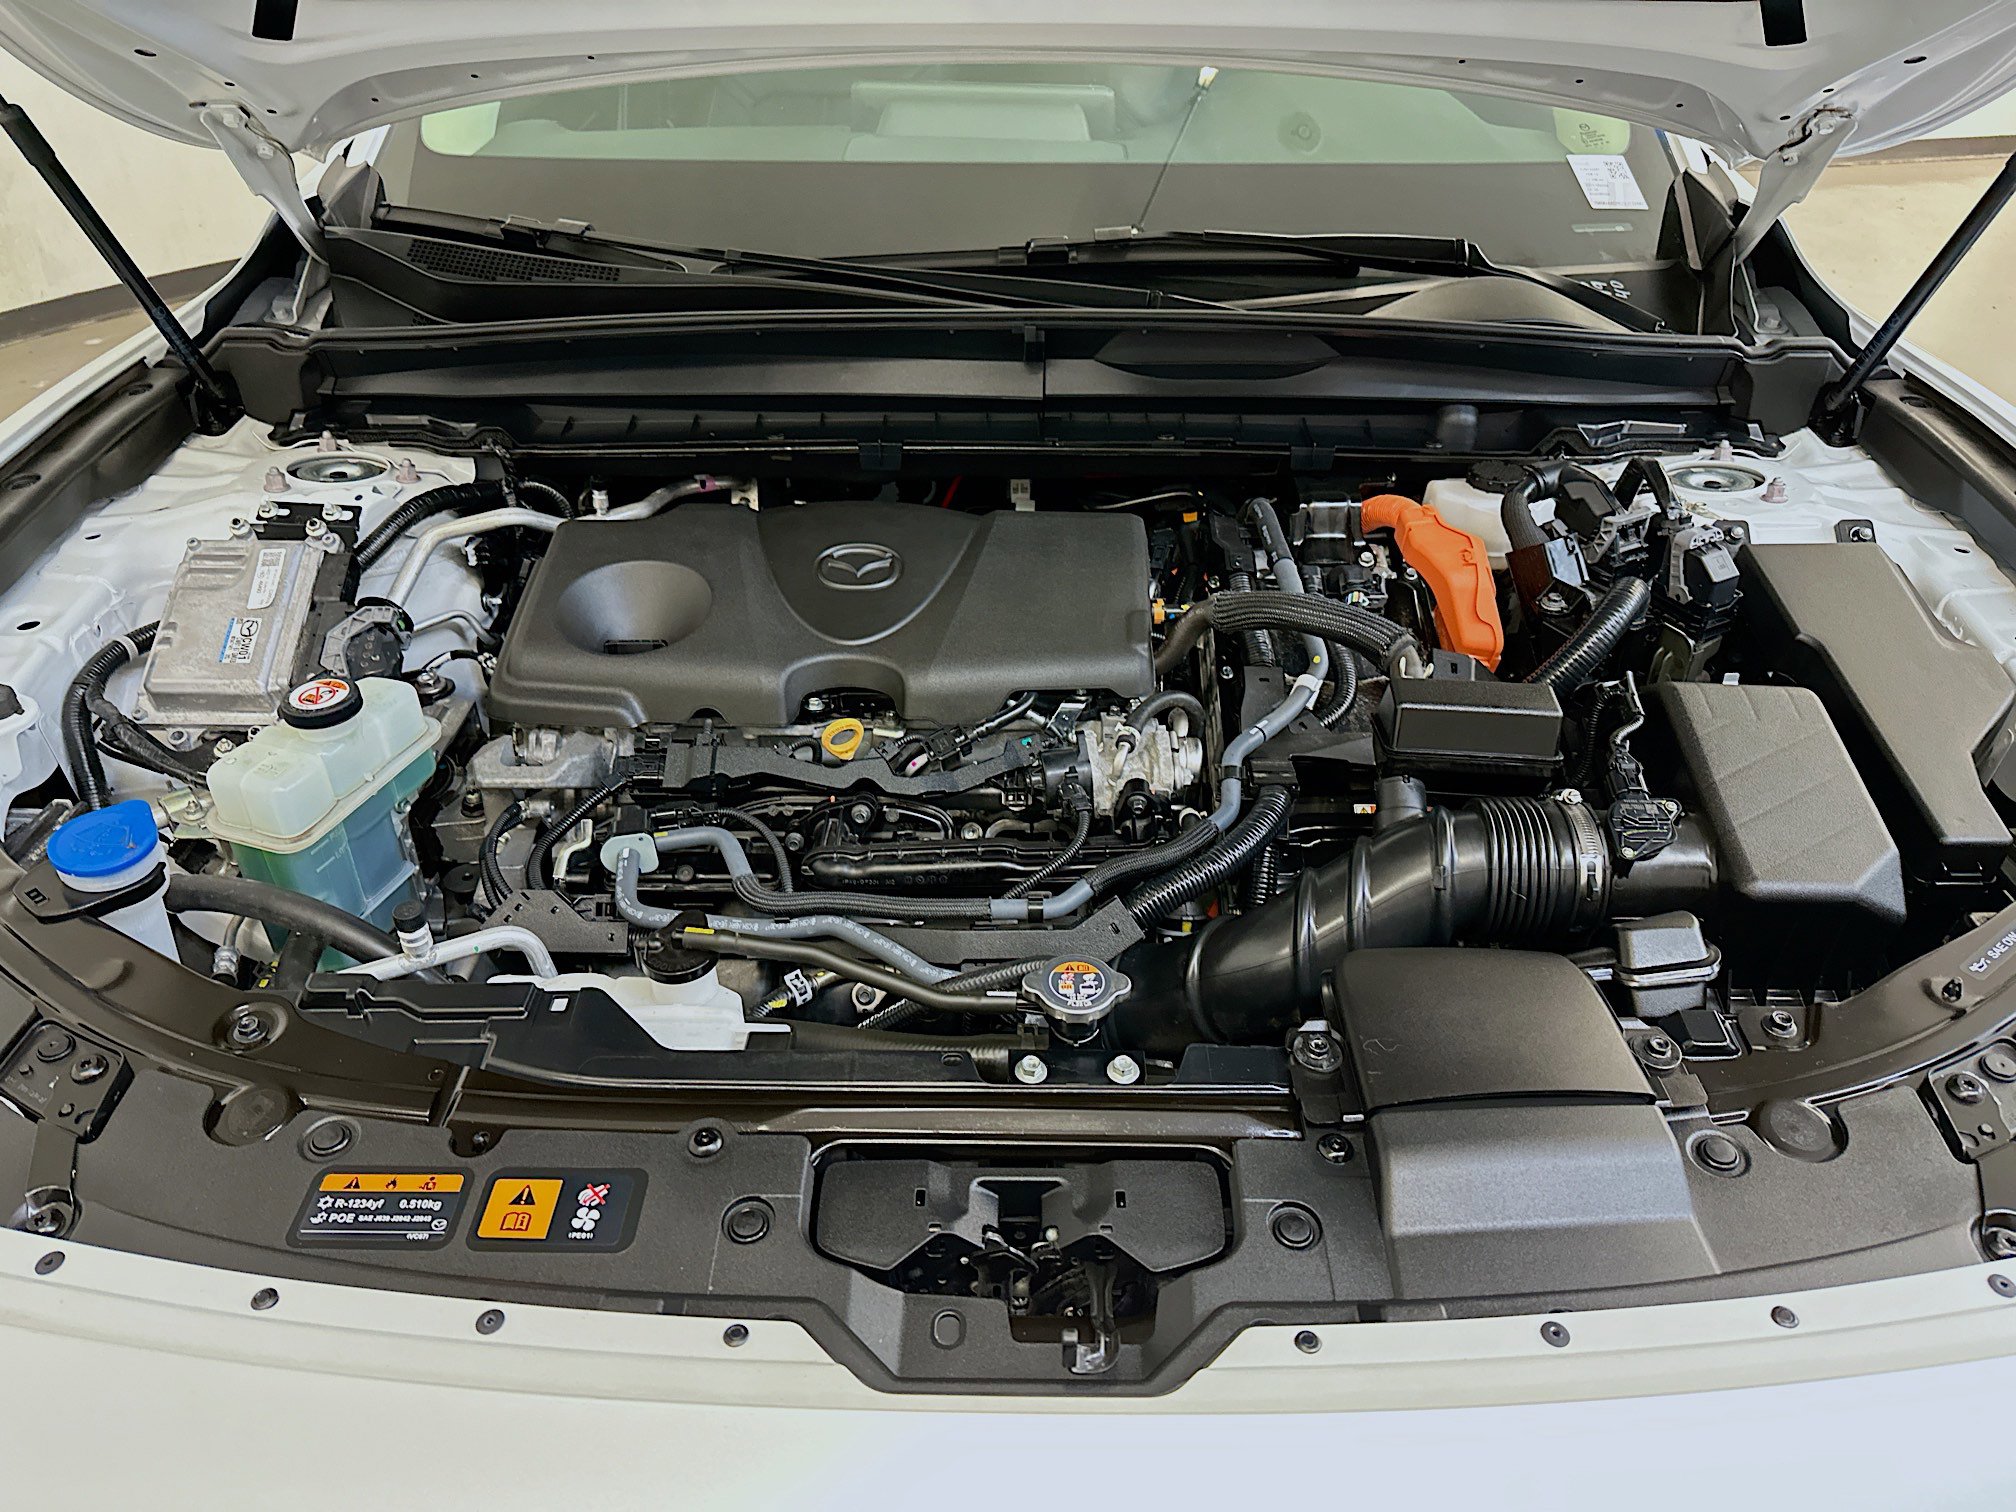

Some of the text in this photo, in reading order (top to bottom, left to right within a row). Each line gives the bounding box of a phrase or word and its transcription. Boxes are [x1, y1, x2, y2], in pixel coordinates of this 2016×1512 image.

[237, 638, 253, 659] CW01
[1987, 942, 2009, 959] SAE
[335, 1198, 442, 1211] R-1234yf 0.510kg
[328, 1213, 356, 1224] POE
